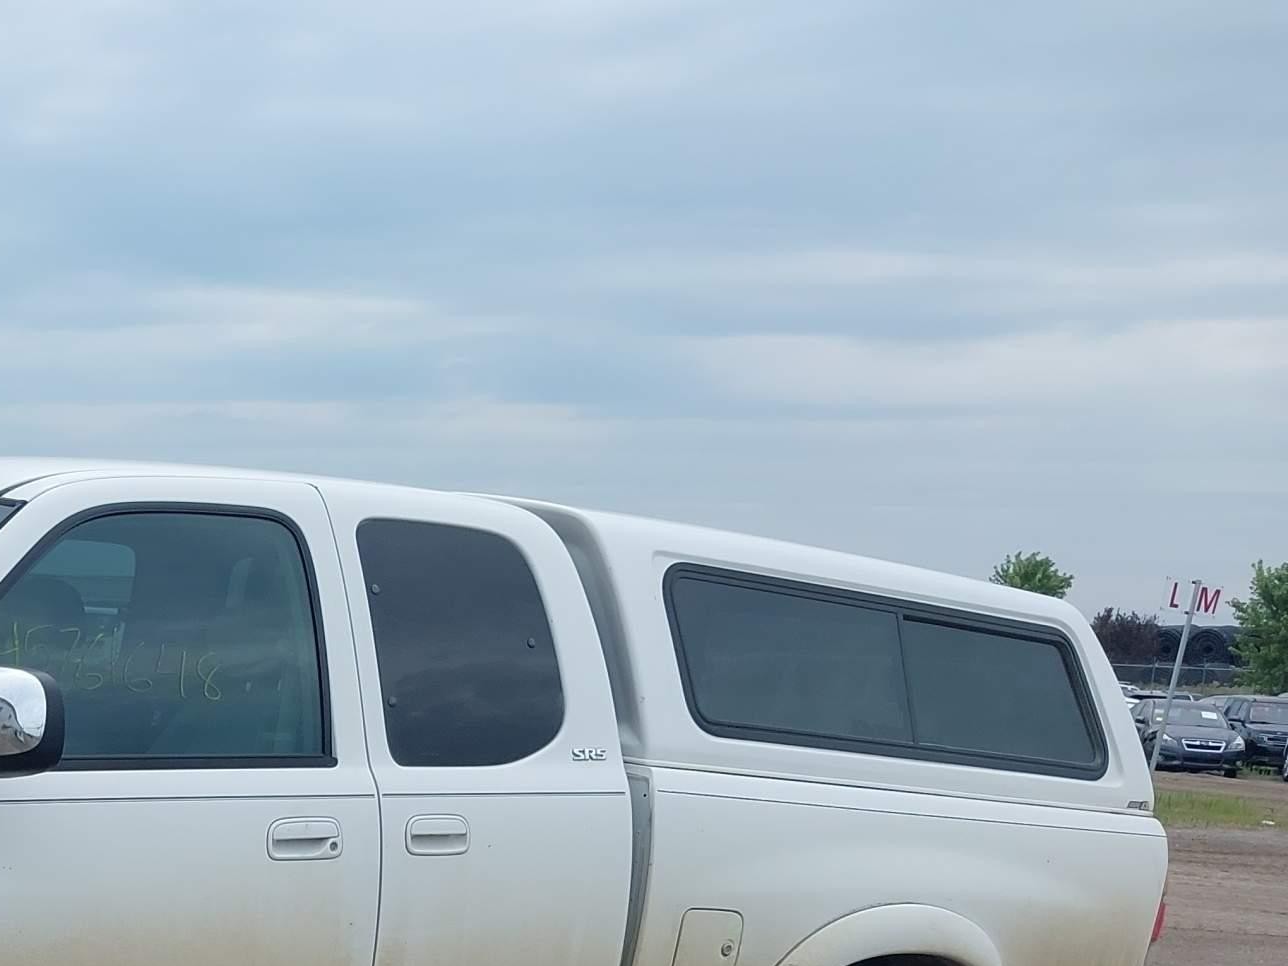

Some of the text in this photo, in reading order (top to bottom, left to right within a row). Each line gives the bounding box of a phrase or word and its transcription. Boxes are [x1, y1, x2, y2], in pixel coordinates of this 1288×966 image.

[1169, 582, 1179, 608] L
[1196, 587, 1221, 614] M
[572, 748, 607, 762] SR5
